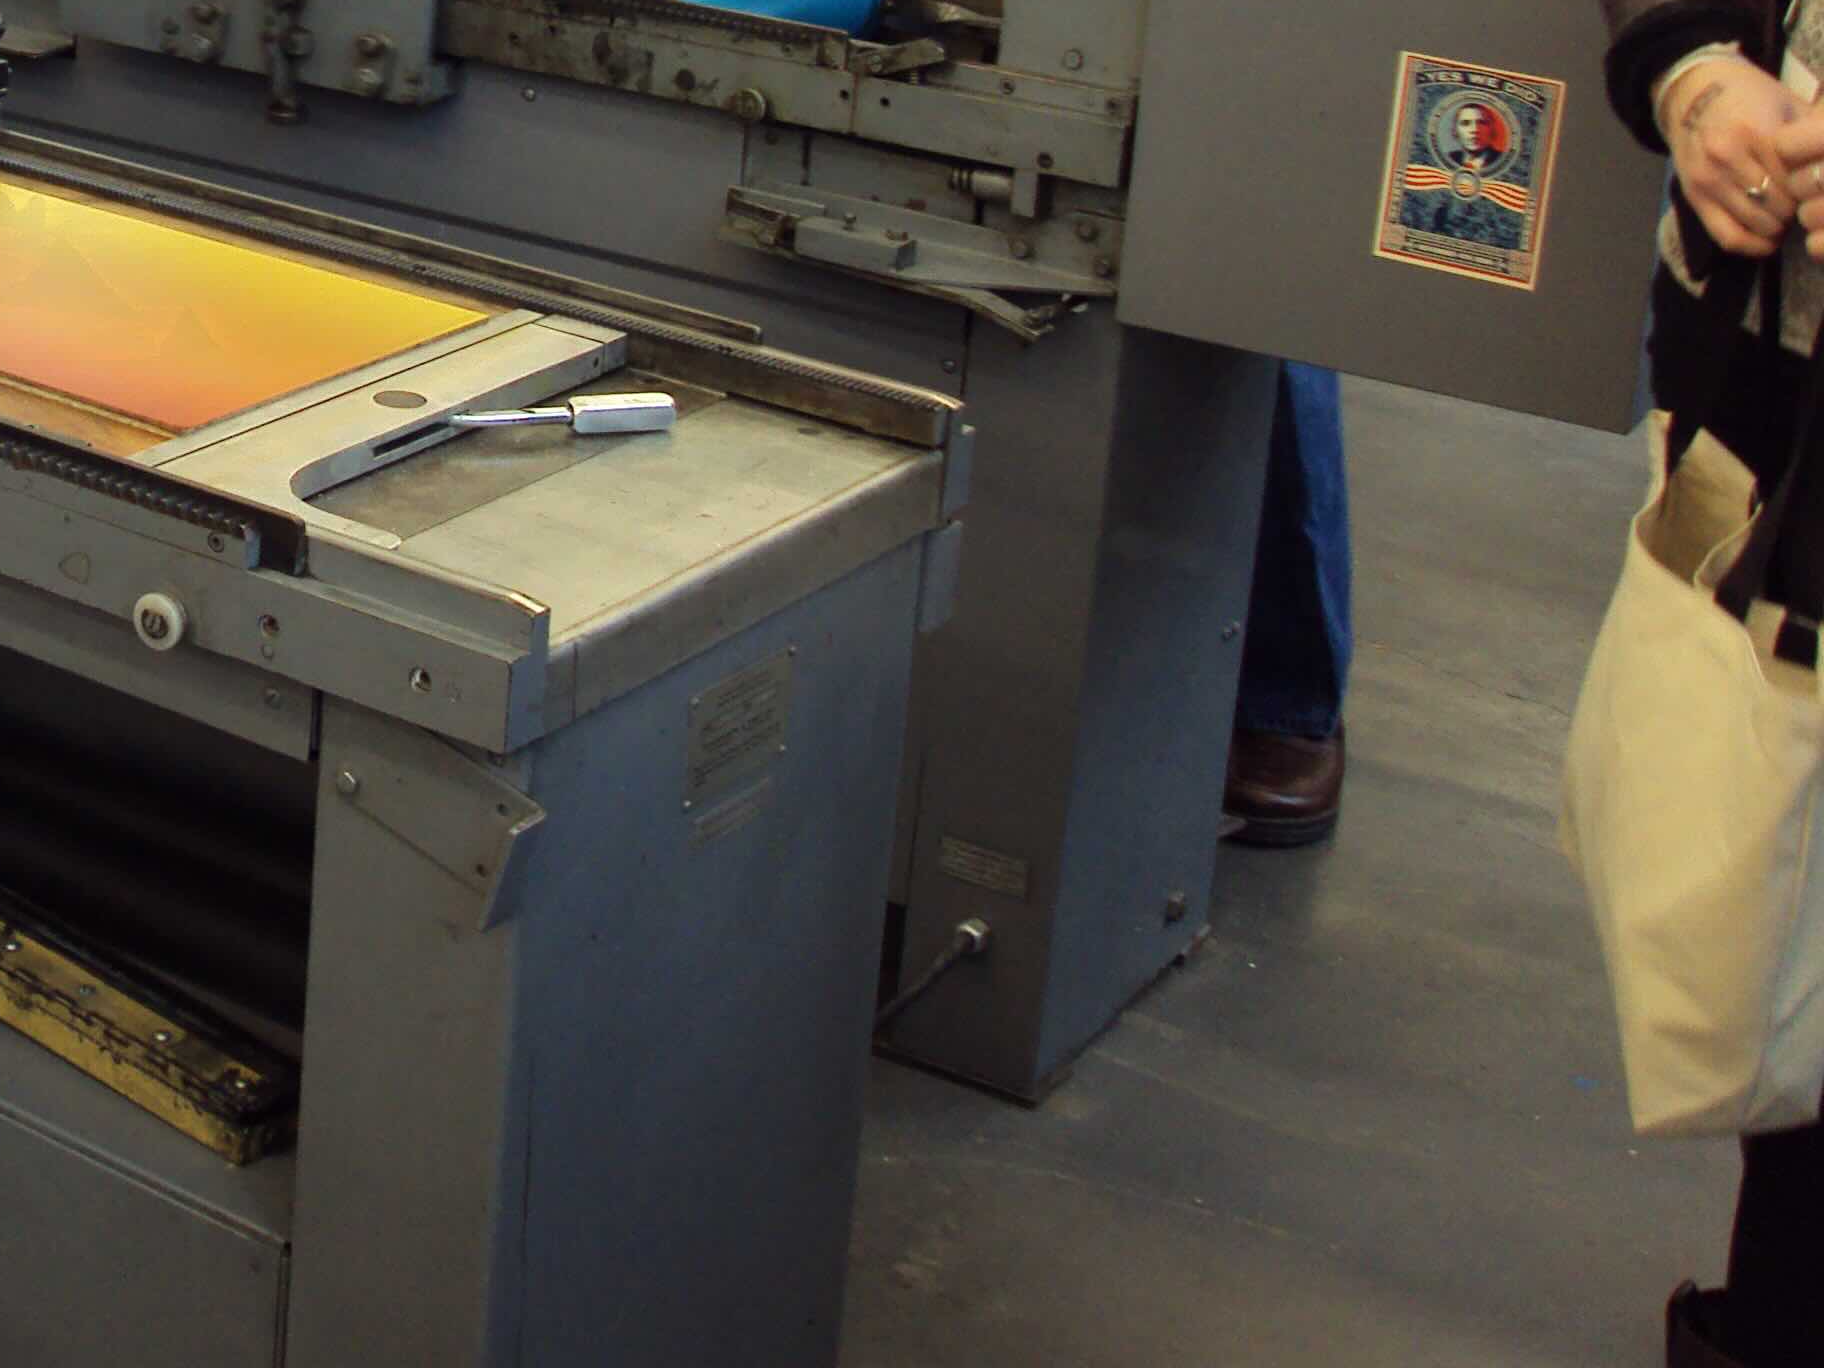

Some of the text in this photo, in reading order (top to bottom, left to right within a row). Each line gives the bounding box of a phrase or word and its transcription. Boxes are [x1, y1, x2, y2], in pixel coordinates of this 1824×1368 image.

[1425, 71, 1538, 102] YES WE DID
